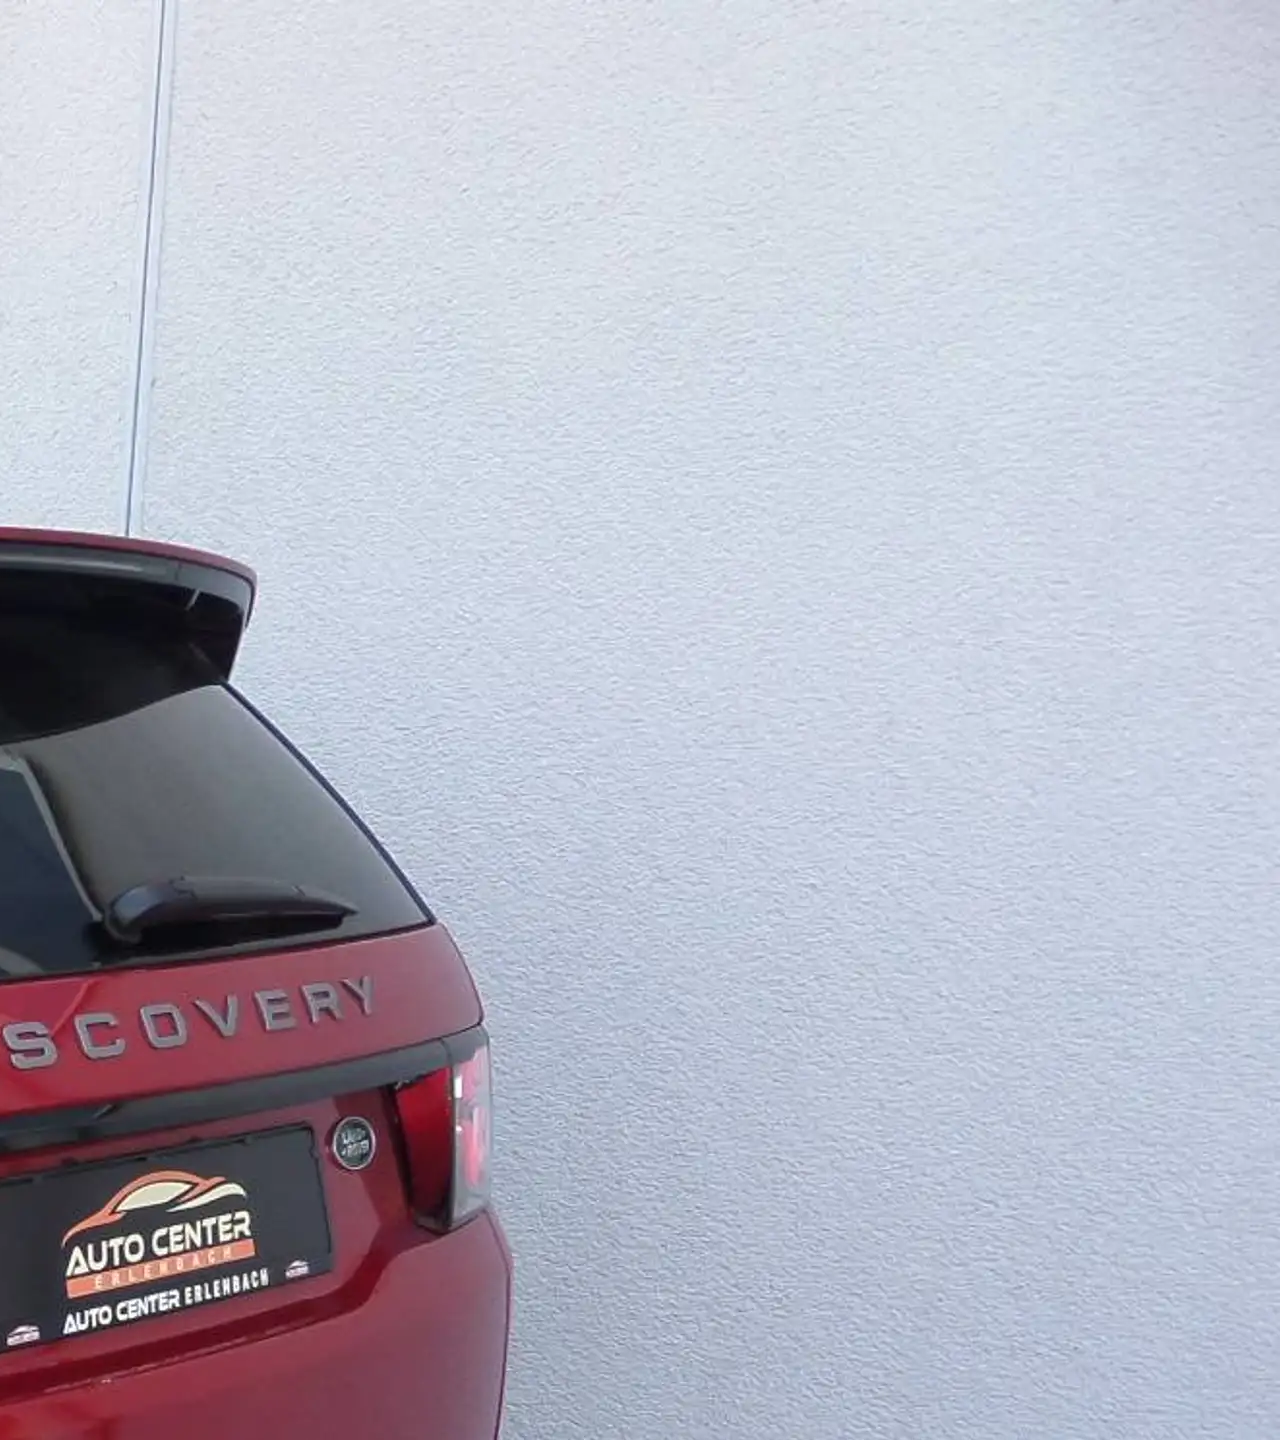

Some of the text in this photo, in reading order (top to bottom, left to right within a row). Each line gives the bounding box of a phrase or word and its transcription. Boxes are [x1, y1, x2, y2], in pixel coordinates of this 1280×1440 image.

[65, 1210, 252, 1277] AUTO CENTER
[93, 1246, 233, 1289] ERLENBACH
[62, 1267, 270, 1335] AUTO CENTER ERLENBACH
